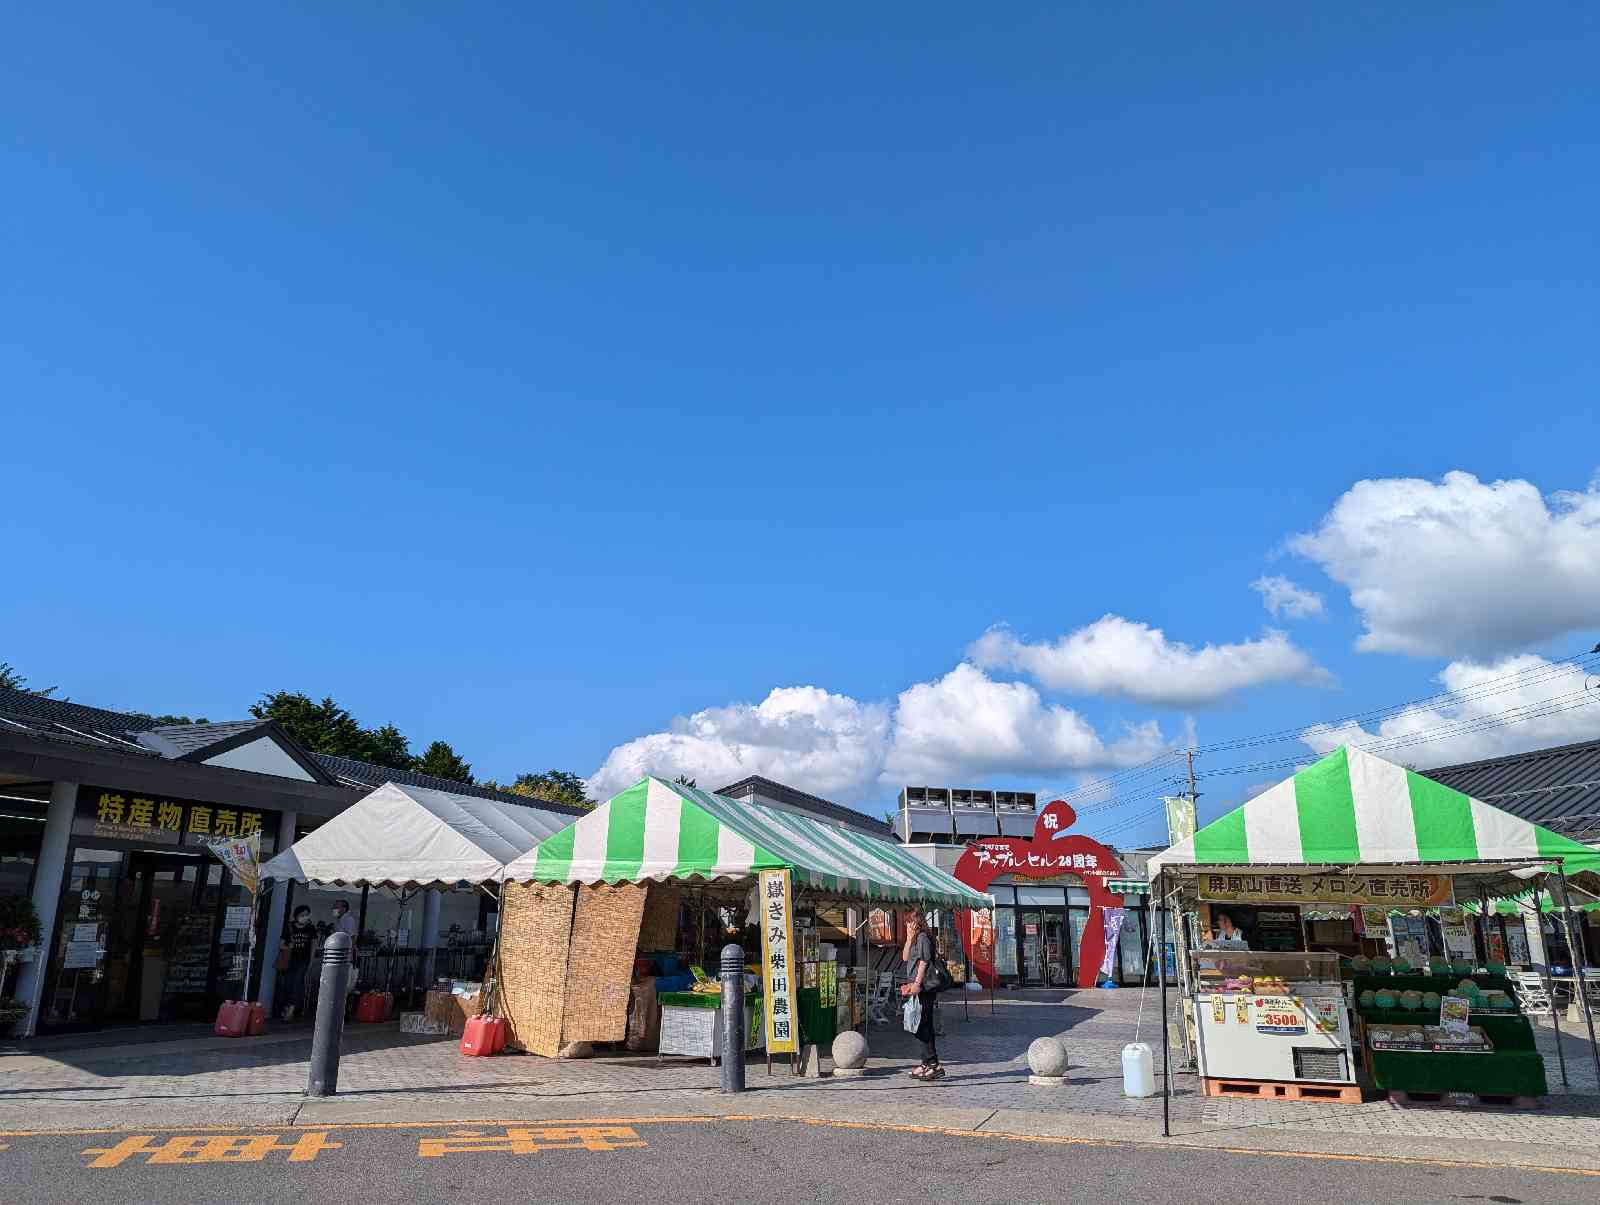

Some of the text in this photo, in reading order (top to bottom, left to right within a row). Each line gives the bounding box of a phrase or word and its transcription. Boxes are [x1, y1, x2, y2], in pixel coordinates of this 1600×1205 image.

[97, 793, 263, 836] 特産物直売所
[1043, 813, 1058, 829] 祝
